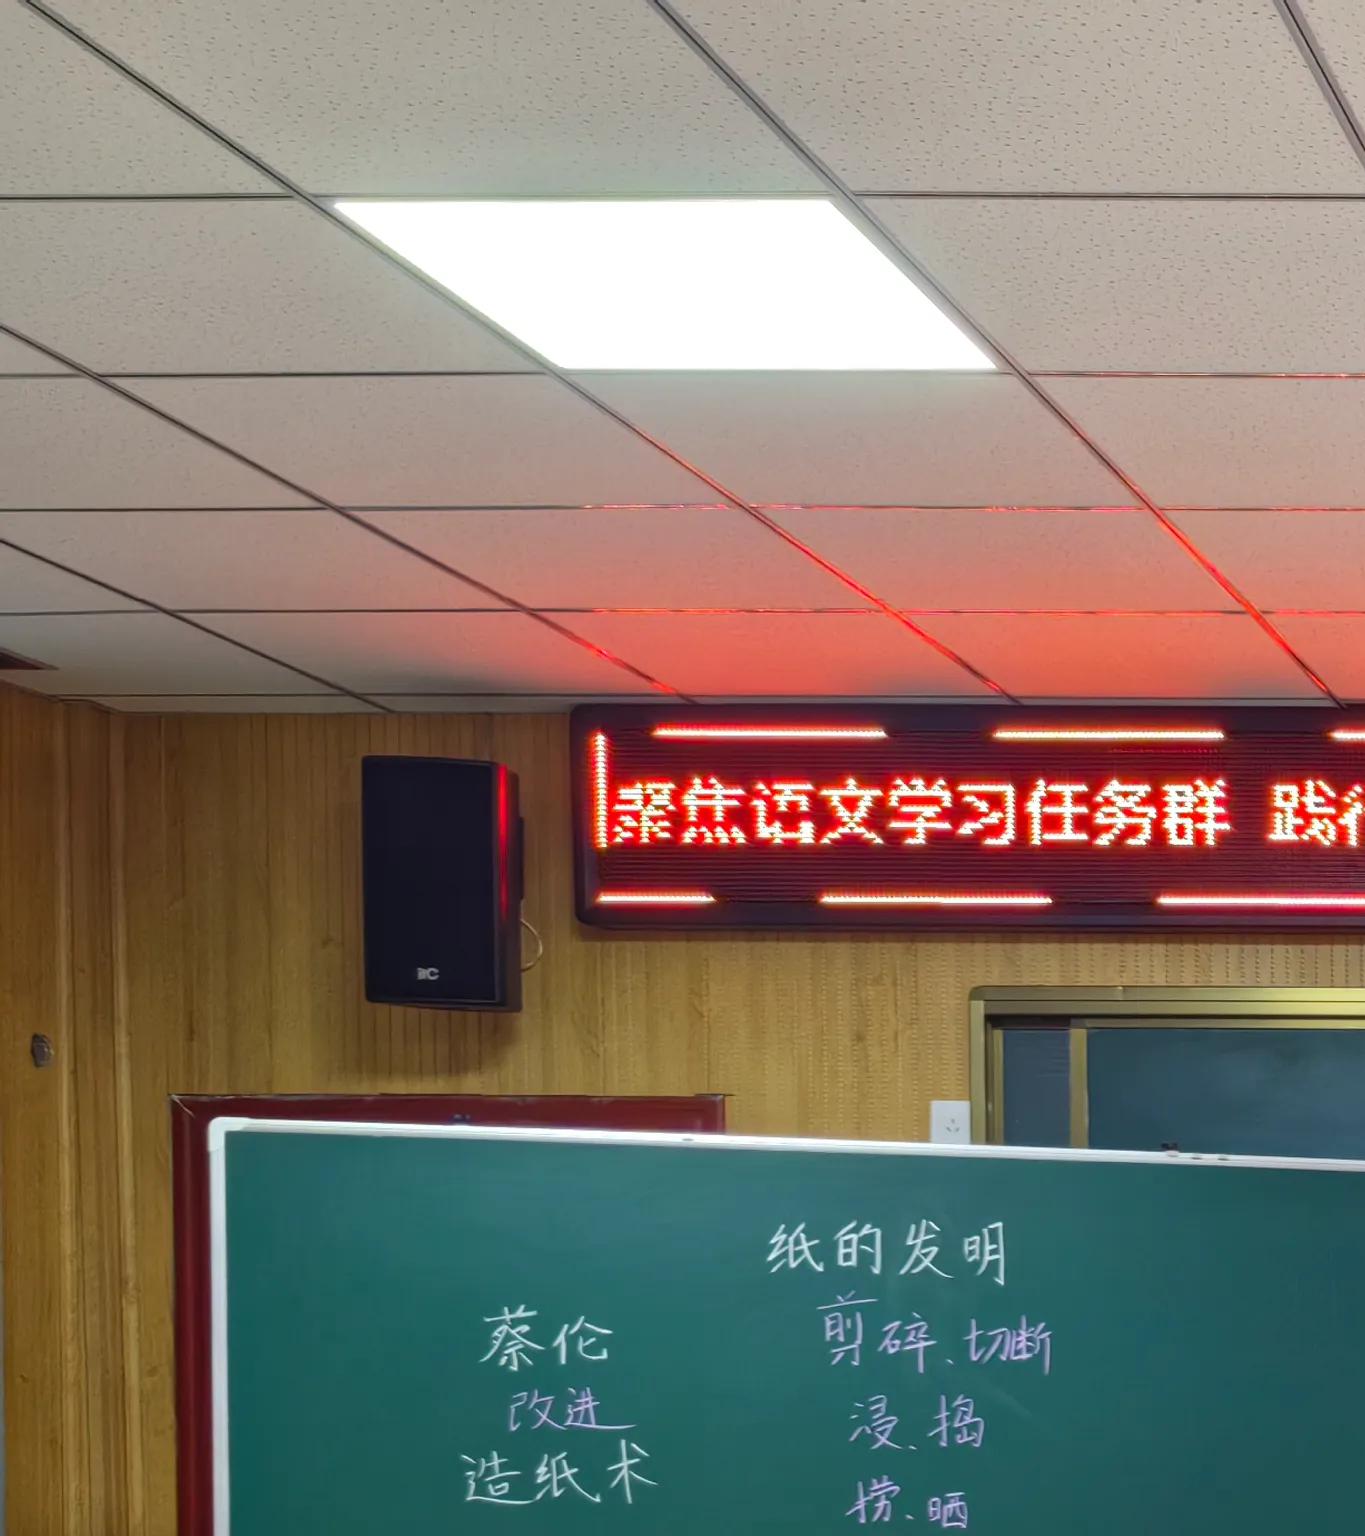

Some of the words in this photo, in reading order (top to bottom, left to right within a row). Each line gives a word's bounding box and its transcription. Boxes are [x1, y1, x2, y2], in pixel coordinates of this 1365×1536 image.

[611, 776, 1232, 847] 聚焦语文学习任务群
[766, 1218, 1006, 1287] 纸的发明
[479, 1304, 614, 1373] 蔡伦
[815, 1290, 1054, 1377] 剪碎、切断
[508, 1386, 637, 1433] 改进
[848, 1394, 986, 1452] 浸、捣
[460, 1438, 659, 1506] 造纸术
